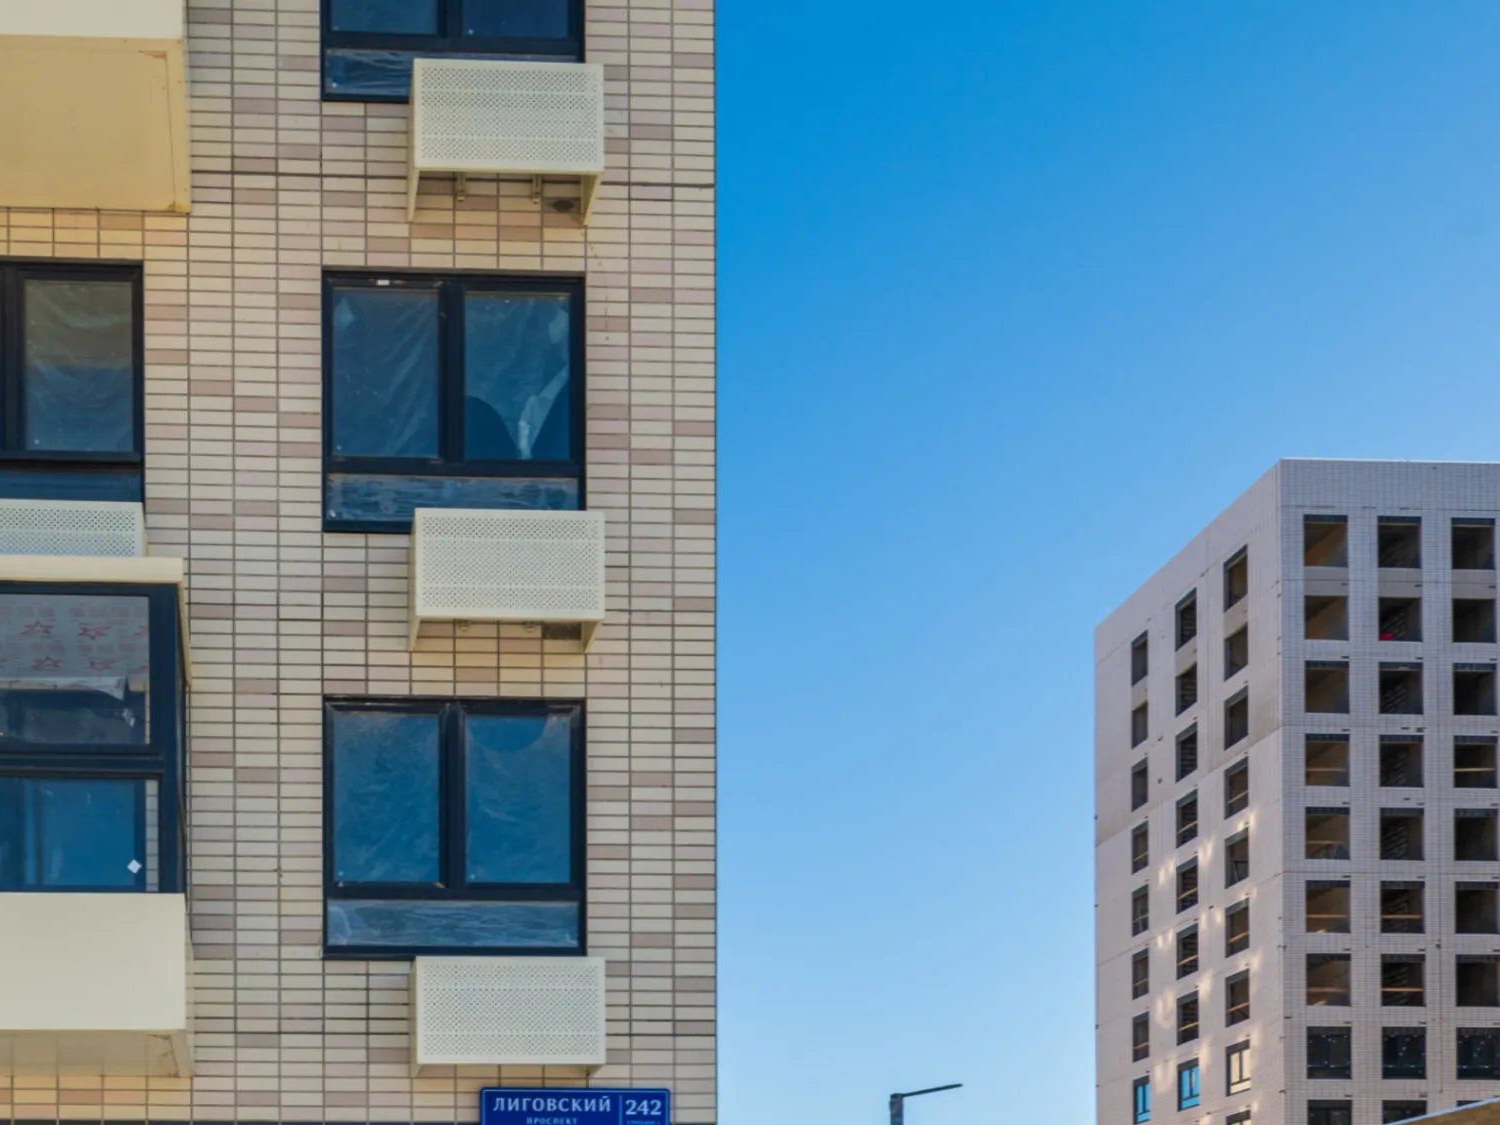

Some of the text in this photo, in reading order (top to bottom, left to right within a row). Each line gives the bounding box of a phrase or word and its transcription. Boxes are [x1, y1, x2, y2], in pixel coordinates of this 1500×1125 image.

[493, 1095, 611, 1112] ЛИГОВСКИЙ
[625, 1099, 662, 1116] 242
[526, 1117, 578, 1125] ПРОСПЕКТ
